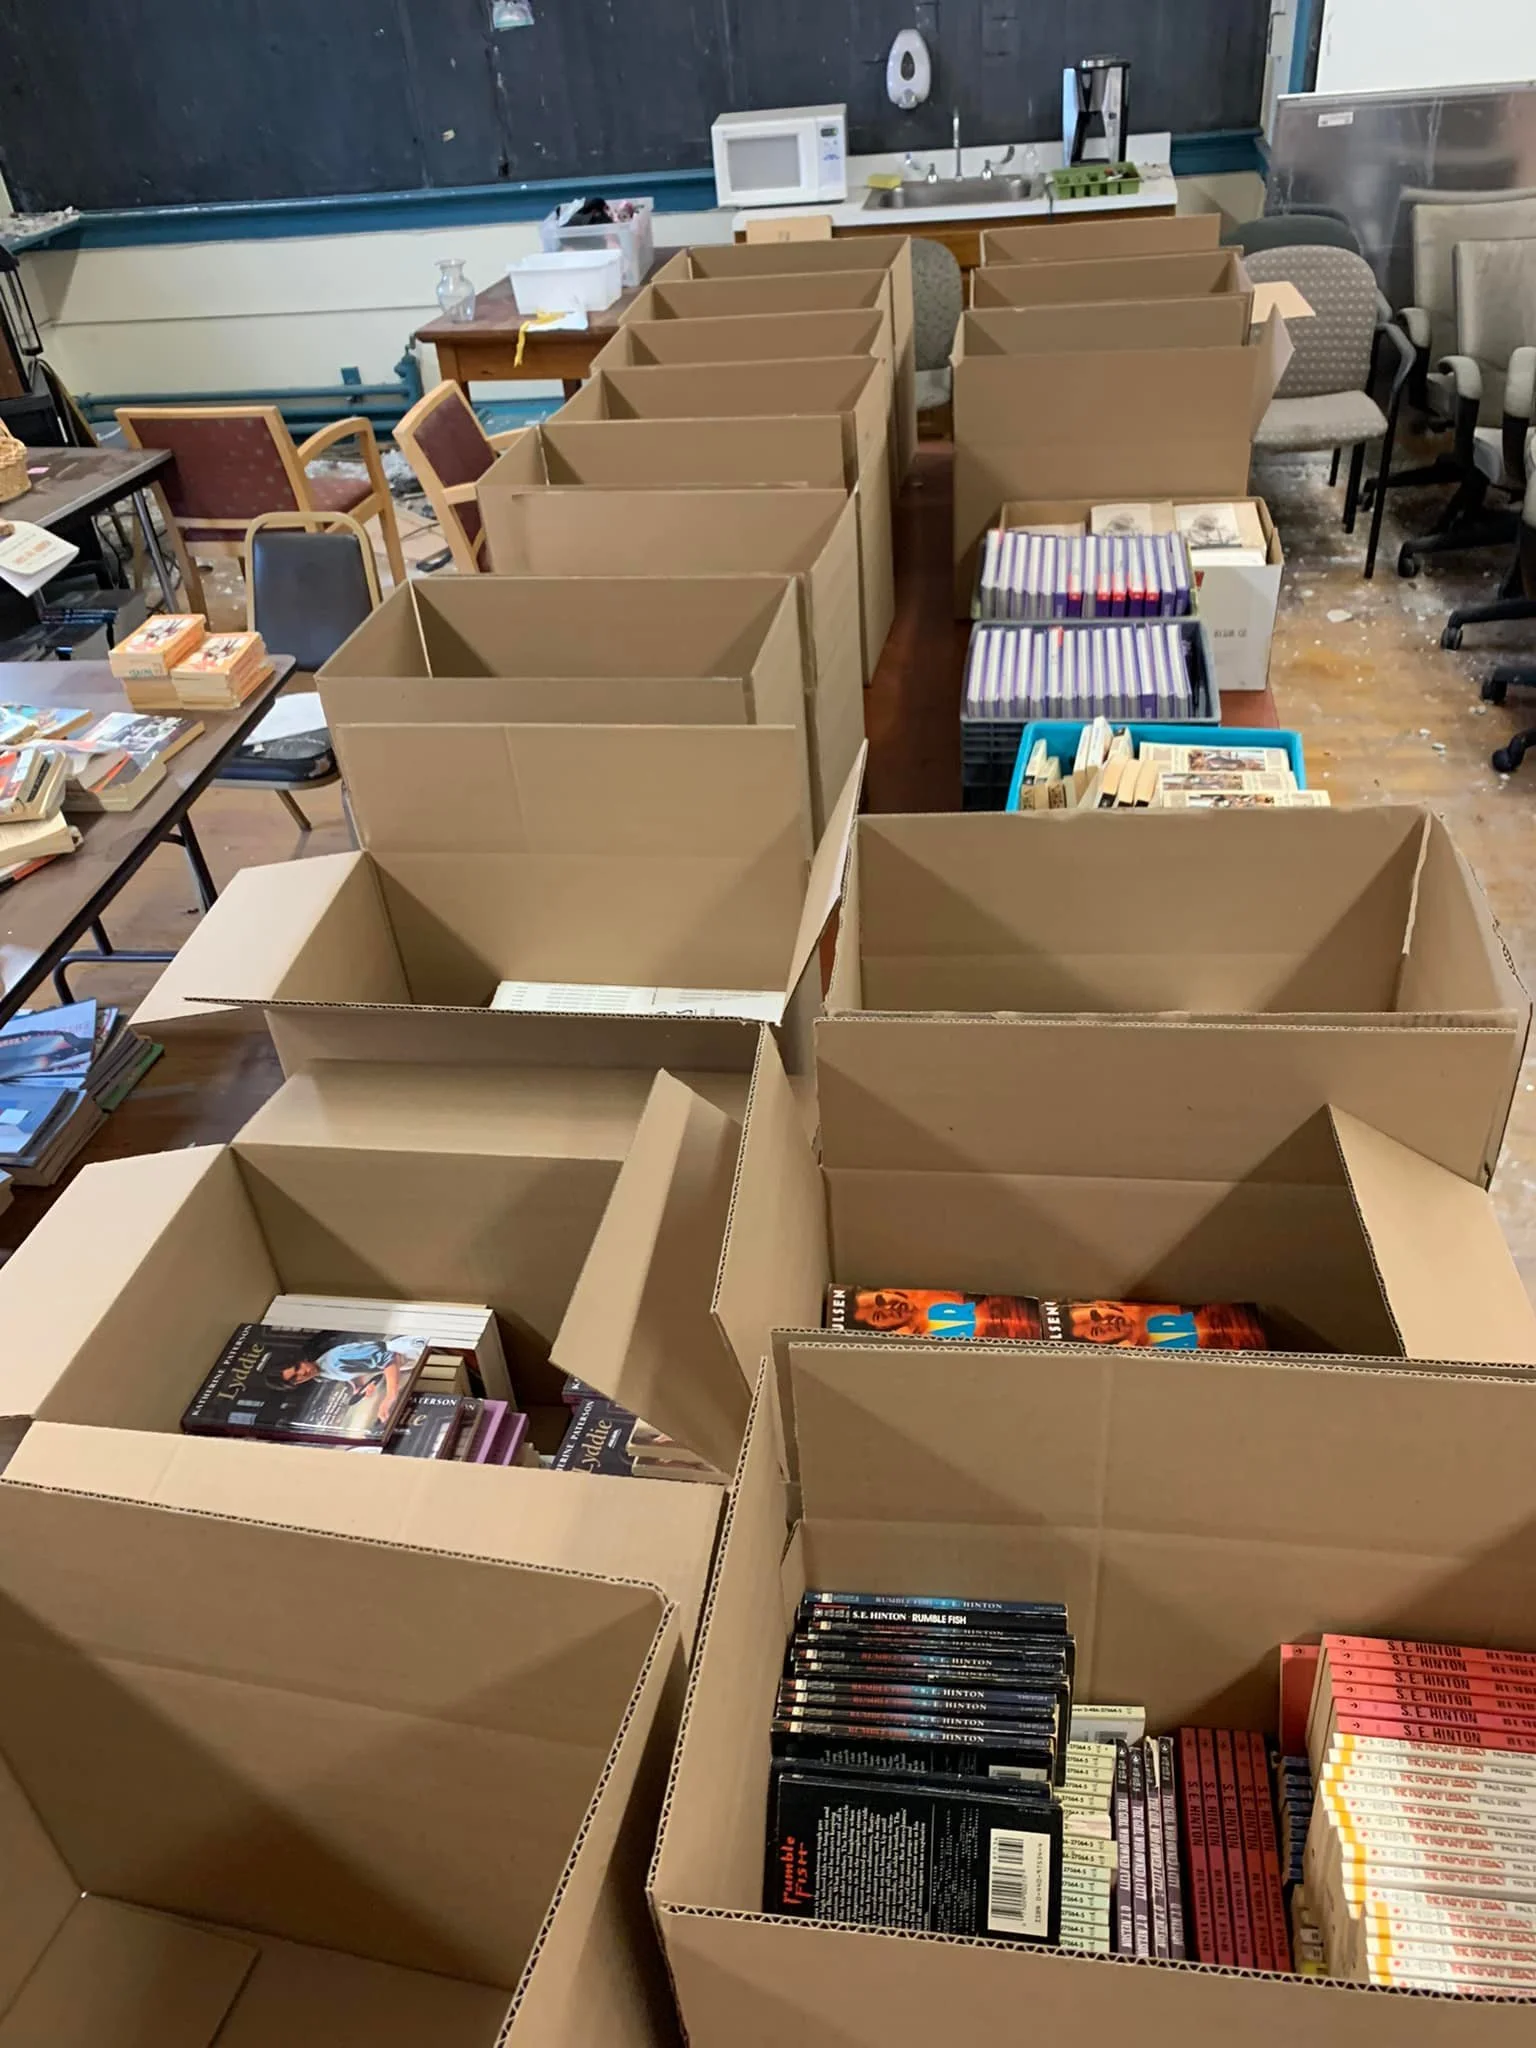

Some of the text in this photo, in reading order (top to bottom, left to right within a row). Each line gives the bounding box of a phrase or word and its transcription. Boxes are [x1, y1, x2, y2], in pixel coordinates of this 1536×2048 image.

[192, 1325, 252, 1415] KATHERINE PATERSON
[217, 1343, 264, 1400] Lyddie
[571, 1400, 595, 1440] PATERSON
[572, 1418, 613, 1472] Lyddie
[963, 1601, 1002, 1609] HINTON
[870, 1612, 906, 1620] HINTON
[911, 1613, 946, 1624] RUMBLE
[947, 1615, 967, 1625] FISH
[1415, 1643, 1462, 1658] HINTON
[952, 1657, 993, 1666] HINTON
[1420, 1656, 1468, 1673] HINTON
[1424, 1674, 1471, 1690] HINTON
[942, 1689, 985, 1698] HINTON
[1424, 1690, 1473, 1707] HINTON
[944, 1701, 987, 1710] HINTON
[941, 1716, 984, 1726] HINTON
[1429, 1707, 1478, 1724] HINTON
[941, 1733, 984, 1743] HINTON
[1432, 1727, 1482, 1744] HINTON
[1188, 1804, 1205, 1847] HINTON
[1205, 1805, 1222, 1847] HINTON
[1224, 1807, 1240, 1849] HINTON
[1243, 1808, 1260, 1851] HINTON
[1259, 1809, 1275, 1852] HINTON
[777, 1835, 805, 1903] rumble
